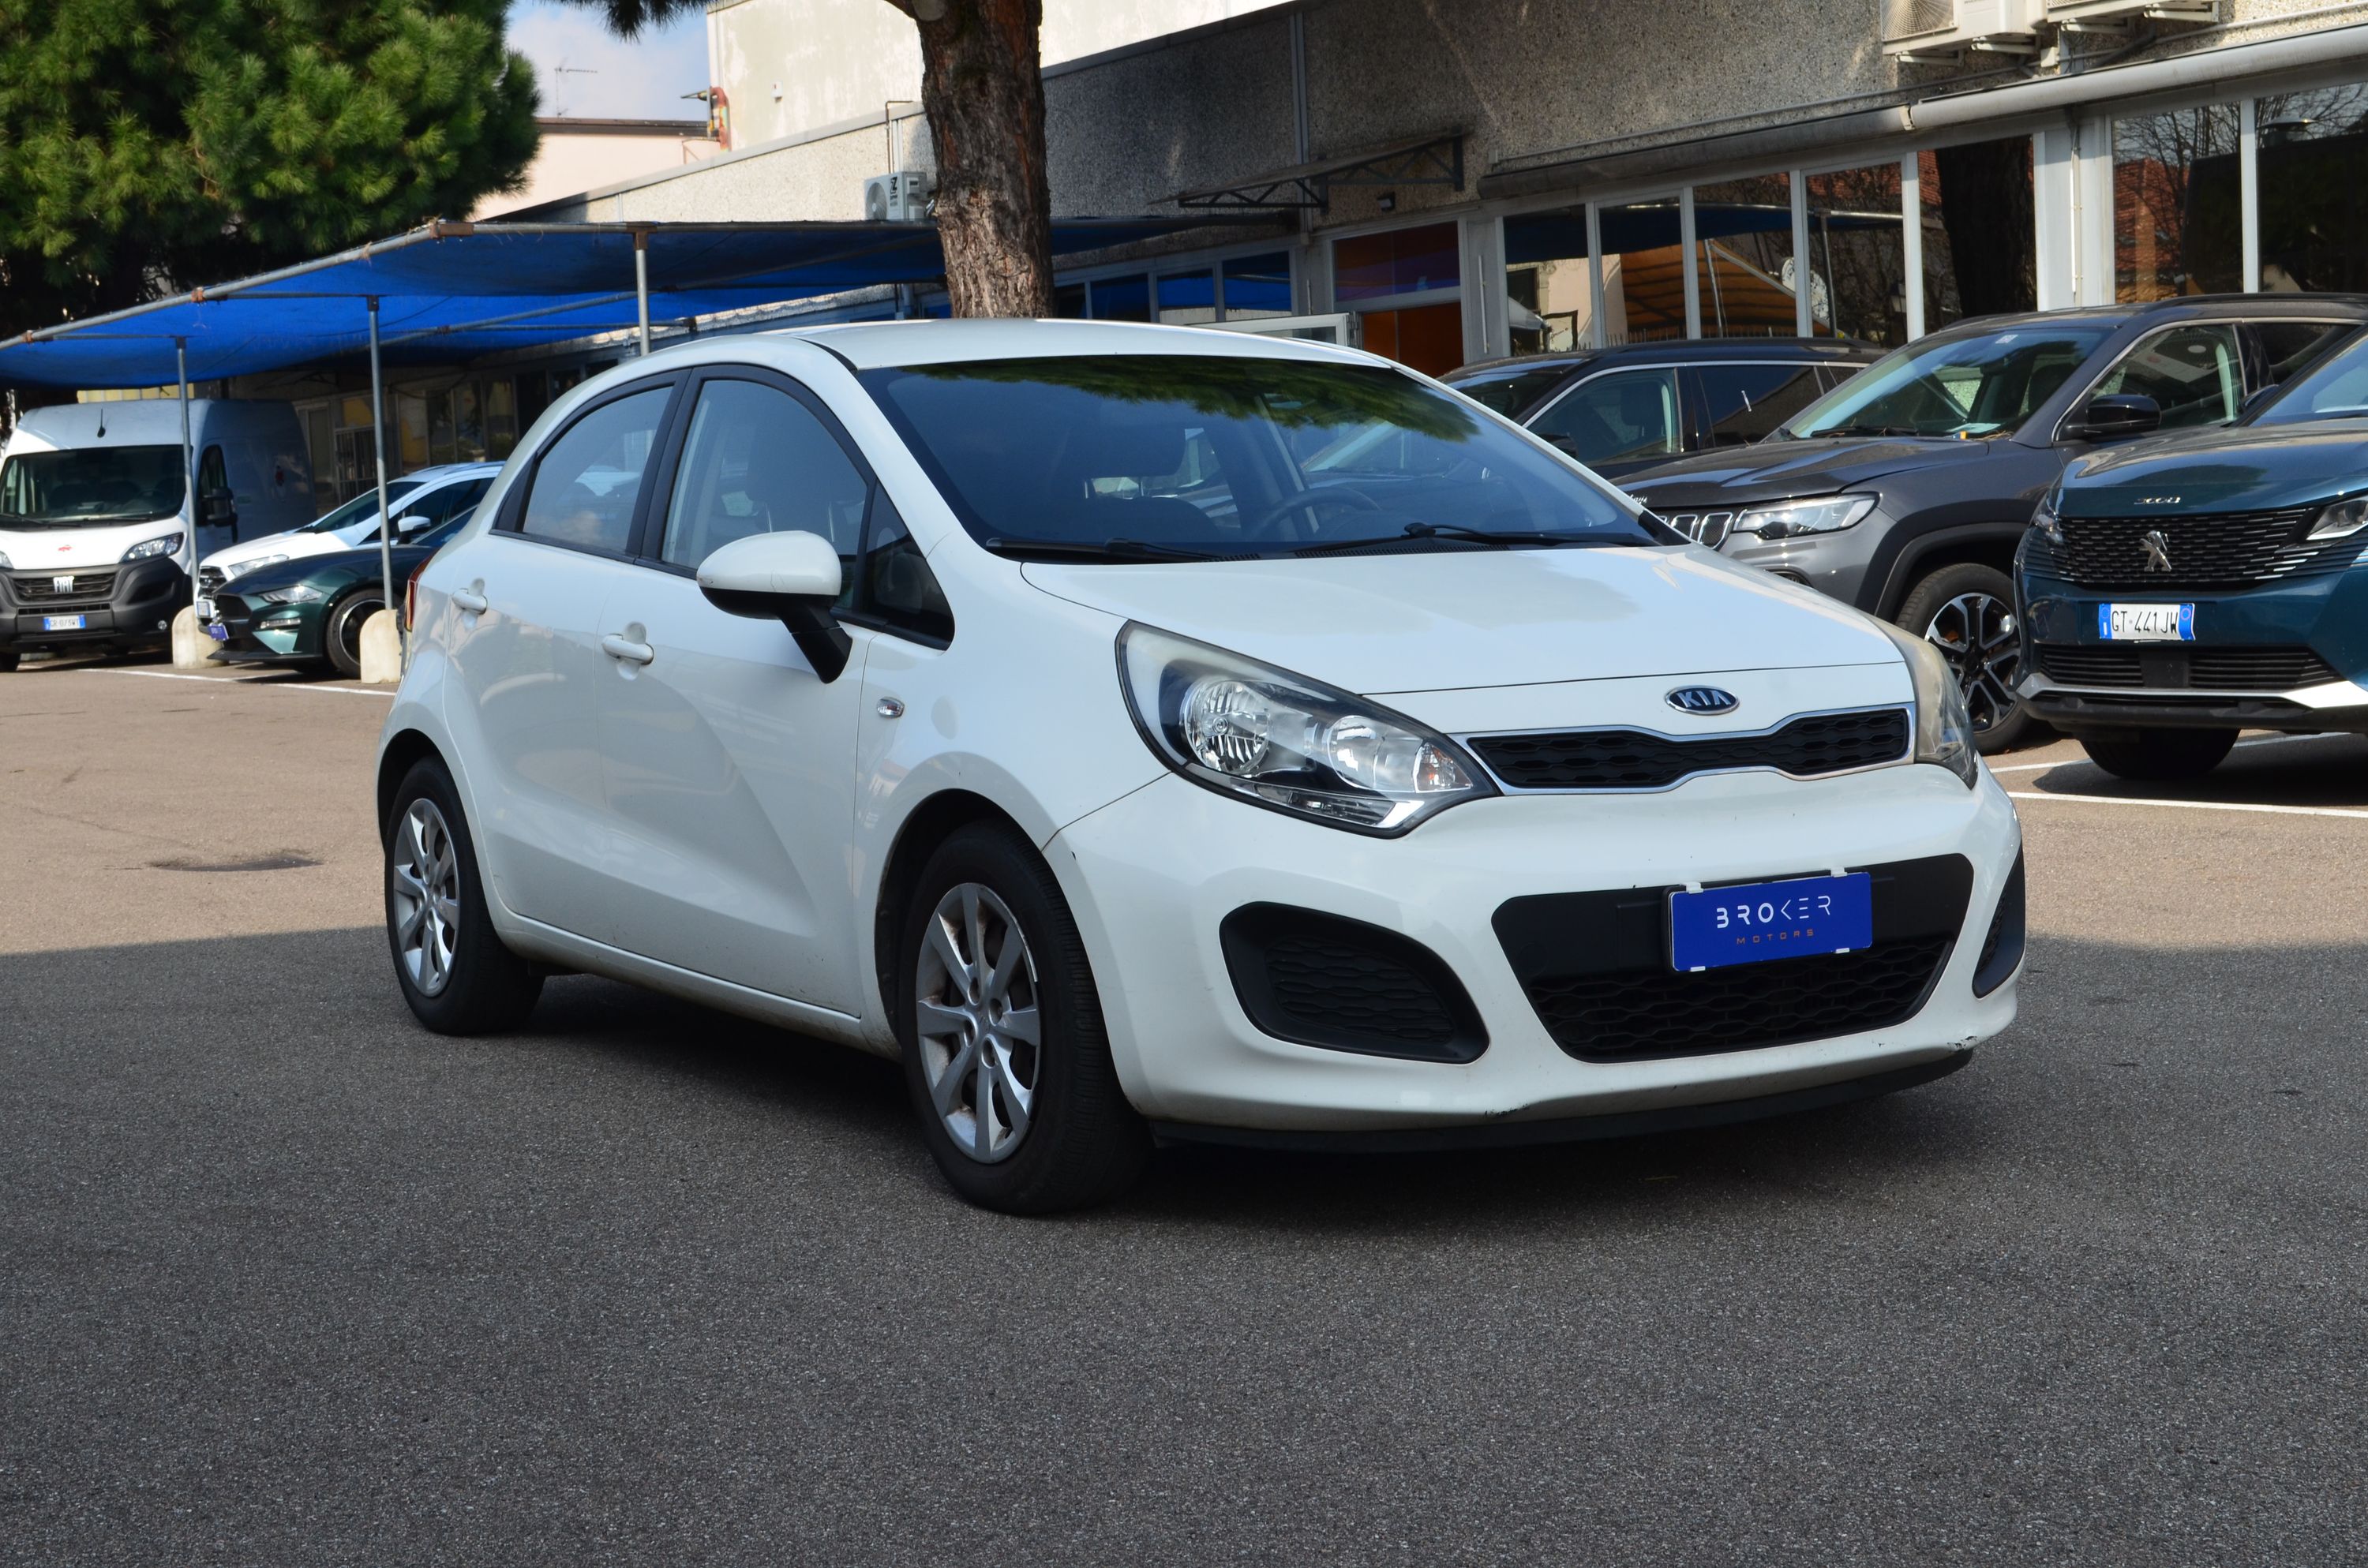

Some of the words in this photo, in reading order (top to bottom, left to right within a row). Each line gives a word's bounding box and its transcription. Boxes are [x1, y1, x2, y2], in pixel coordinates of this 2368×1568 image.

[53, 576, 75, 593] FIAT
[2111, 611, 2128, 633] GT
[2134, 612, 2179, 634] 441JW
[1676, 690, 1732, 709] KIA
[1716, 895, 1831, 929] BROKER
[1736, 929, 1815, 945] MOTORS
